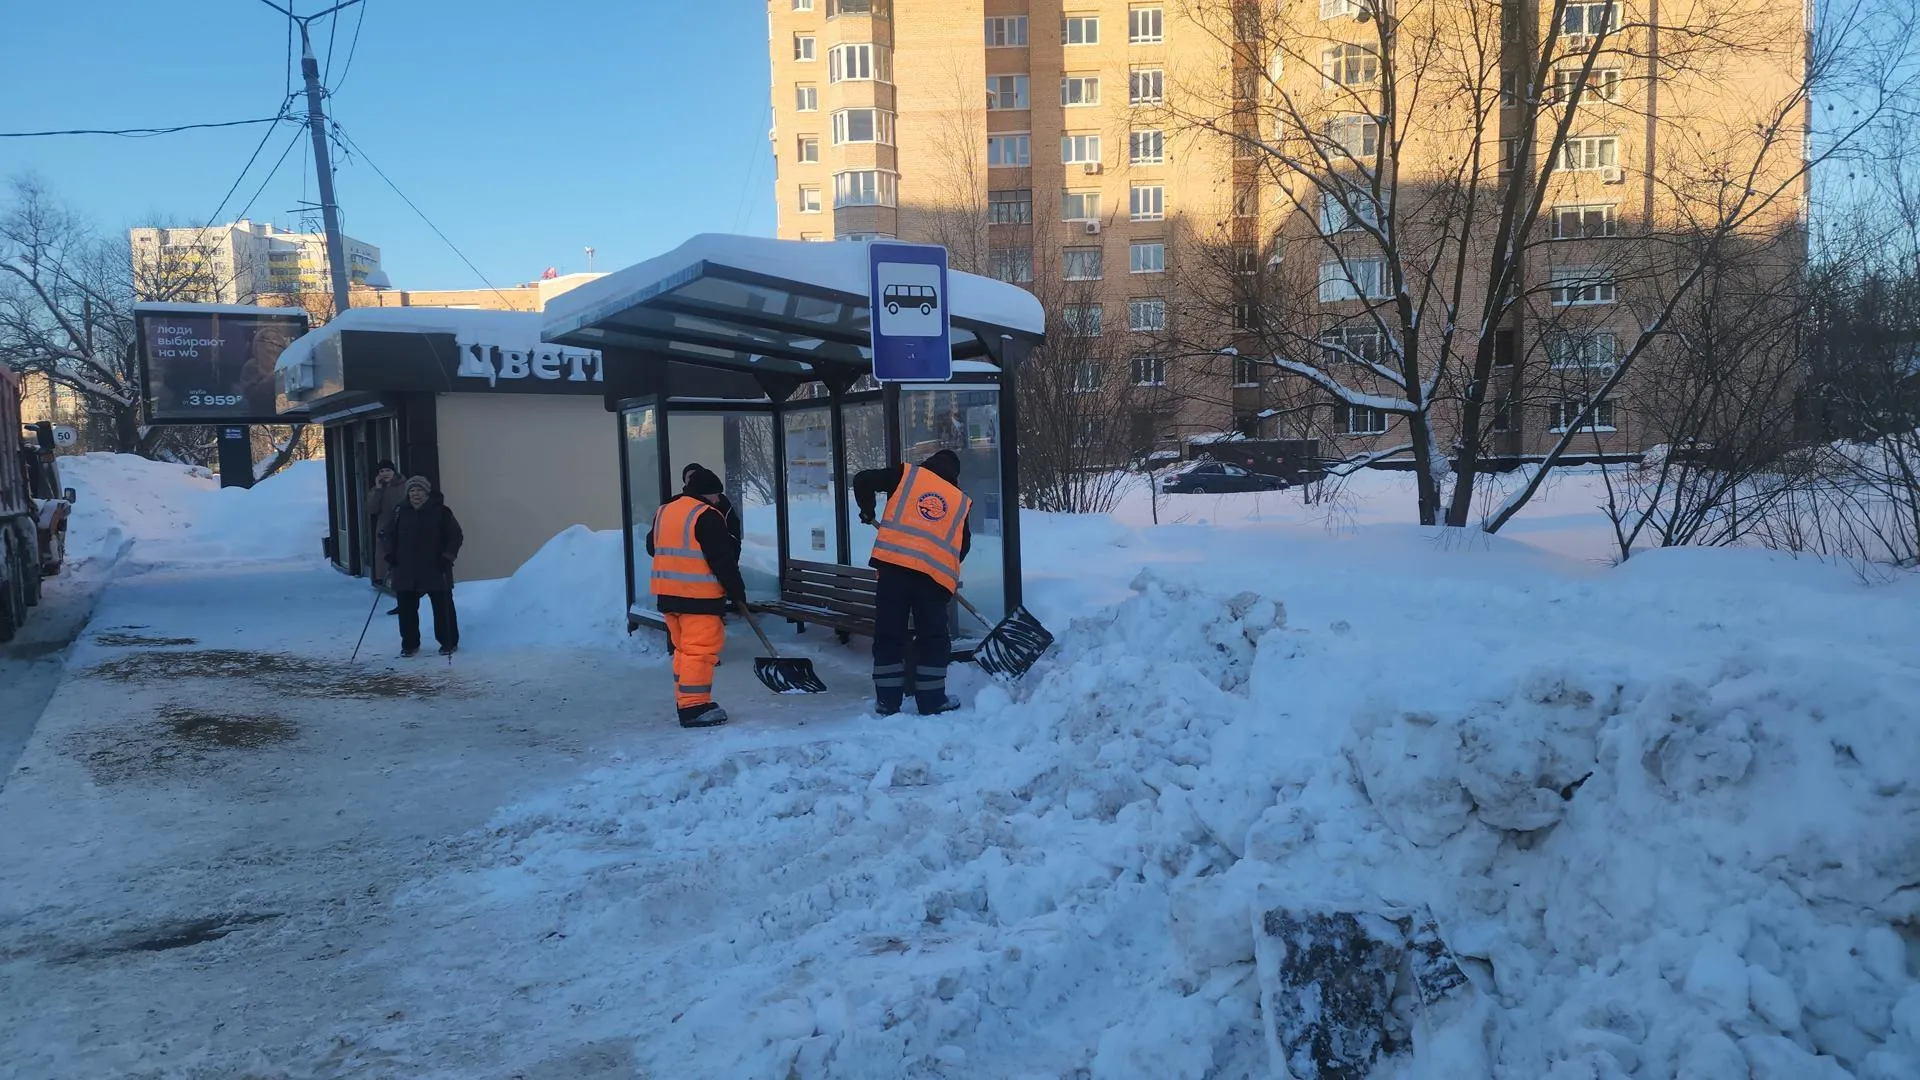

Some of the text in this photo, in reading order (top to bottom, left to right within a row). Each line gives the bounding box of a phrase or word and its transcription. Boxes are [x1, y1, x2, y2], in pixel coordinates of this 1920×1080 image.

[157, 326, 192, 335] люди
[157, 335, 225, 347] выбирают
[158, 349, 175, 357] на
[57, 431, 71, 441] 50
